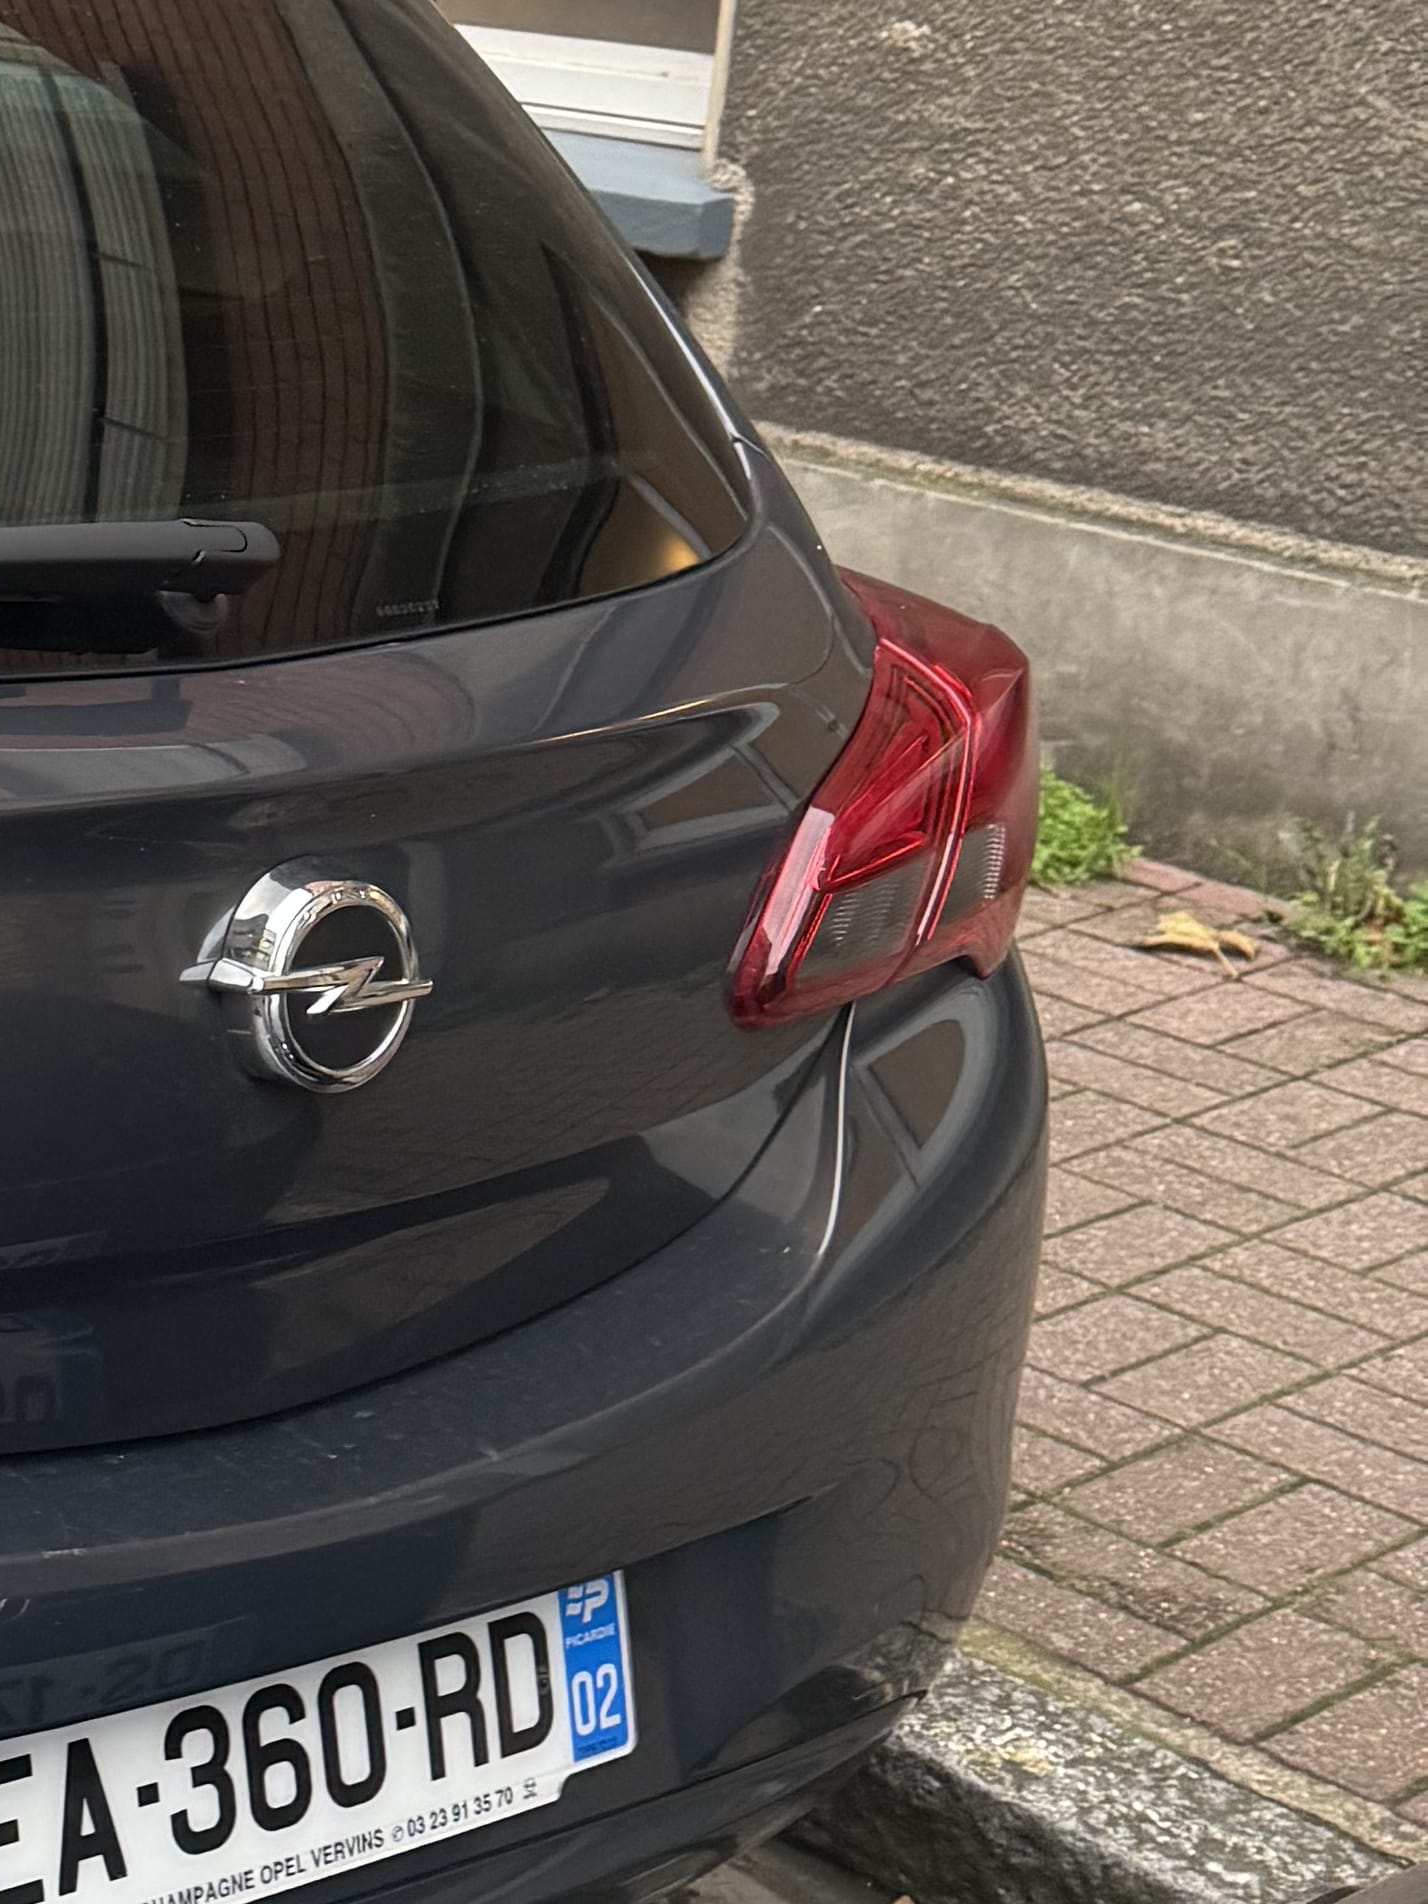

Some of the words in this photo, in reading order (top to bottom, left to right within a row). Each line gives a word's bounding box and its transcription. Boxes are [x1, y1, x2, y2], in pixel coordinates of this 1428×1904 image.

[565, 1622, 616, 1649] PICARDIE
[570, 1662, 622, 1737] 02
[259, 1853, 306, 1884] OPEL
[310, 1828, 385, 1868] VERVINS
[406, 1818, 427, 1838] 03
[429, 1810, 448, 1831] 23
[451, 1801, 469, 1823] 91
[473, 1793, 493, 1816] 35
[494, 1786, 514, 1809] 70
